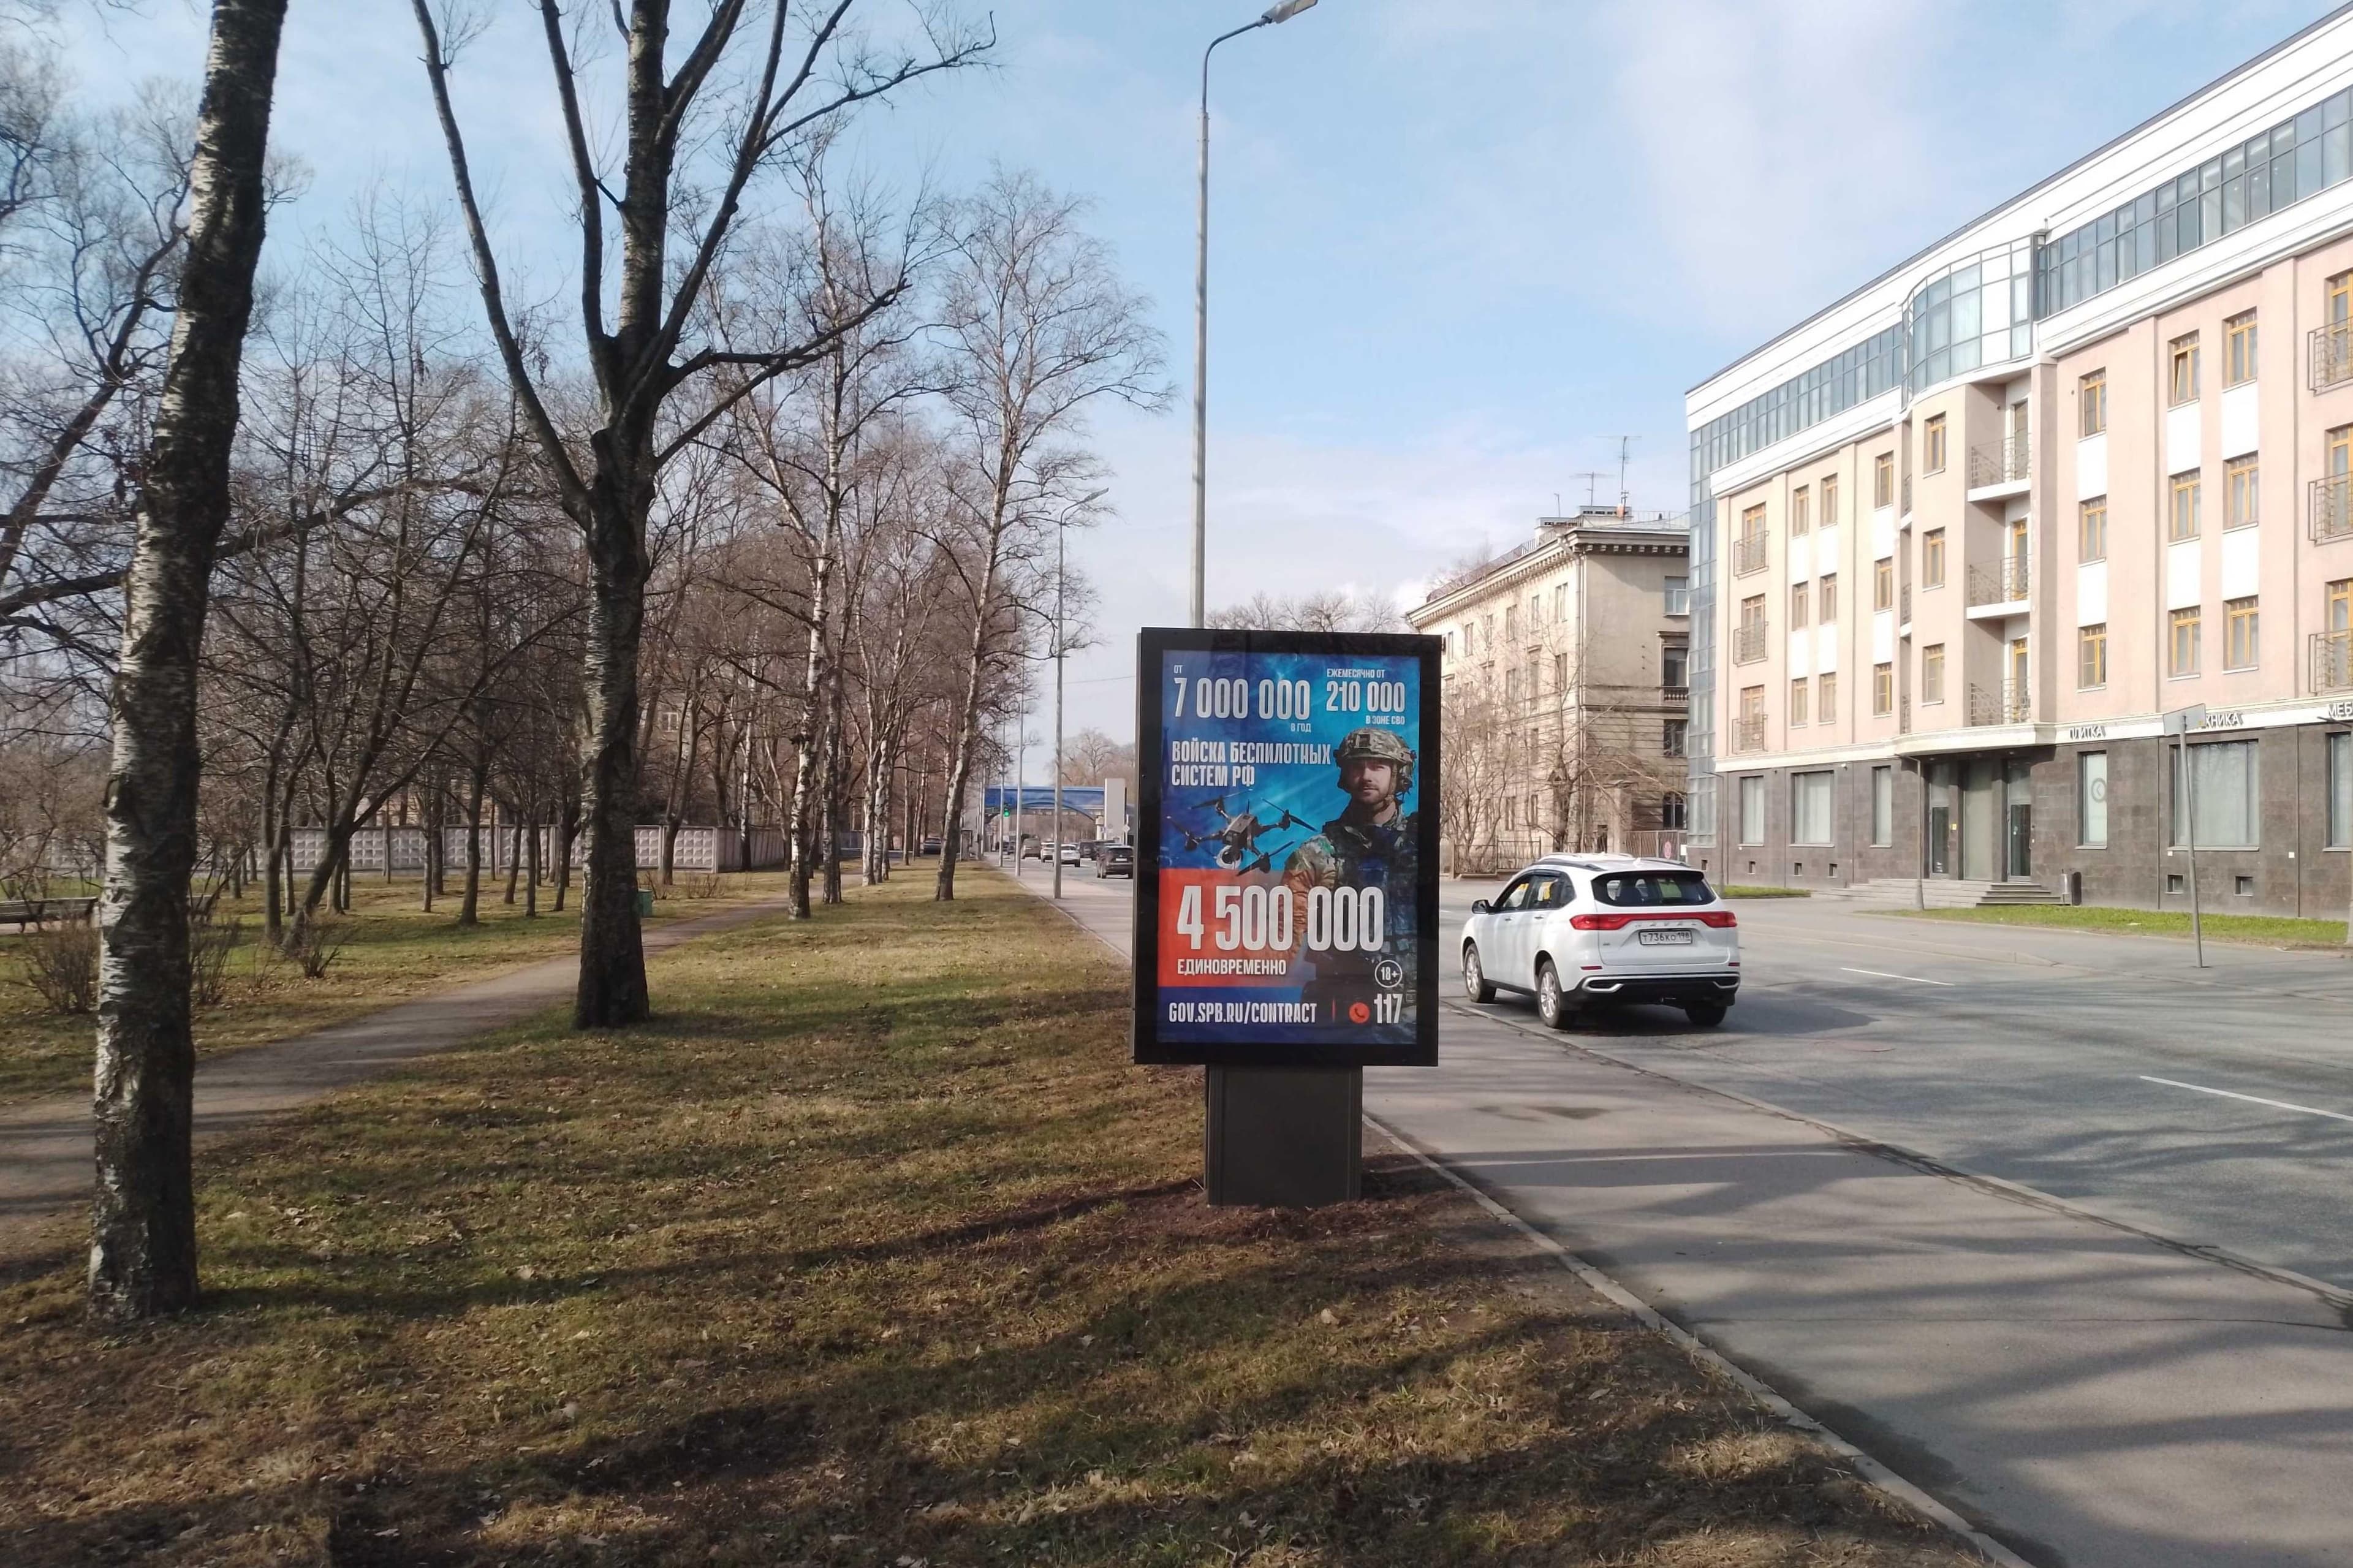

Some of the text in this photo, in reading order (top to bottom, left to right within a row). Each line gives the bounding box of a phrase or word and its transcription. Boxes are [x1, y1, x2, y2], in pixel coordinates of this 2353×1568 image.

[1173, 664, 1183, 674] ОТ
[1327, 668, 1385, 678] ЕЖЕМЕСЯЧНО ОТ
[1173, 677, 1311, 721] 7 000 000
[1326, 680, 1405, 713] 210 000
[1290, 722, 1312, 733] В ГОД
[1365, 715, 1406, 725] В ЗОНЕ СВО
[2201, 712, 2243, 729] ХНИКА
[2069, 725, 2106, 740] ПЛИТКА
[1172, 737, 1332, 765] ВОЙСКА БЕСПИЛОТНЫХ
[1171, 764, 1256, 787] СИСТЕМ РФ
[1176, 885, 1384, 951] 4 500 000
[1177, 958, 1287, 976] ЕДИНОВРЕМЕННО
[1380, 966, 1401, 980] 18+
[1169, 1001, 1317, 1025] GOV.SPB.RU/CONTRACT
[1373, 993, 1403, 1024] 117
